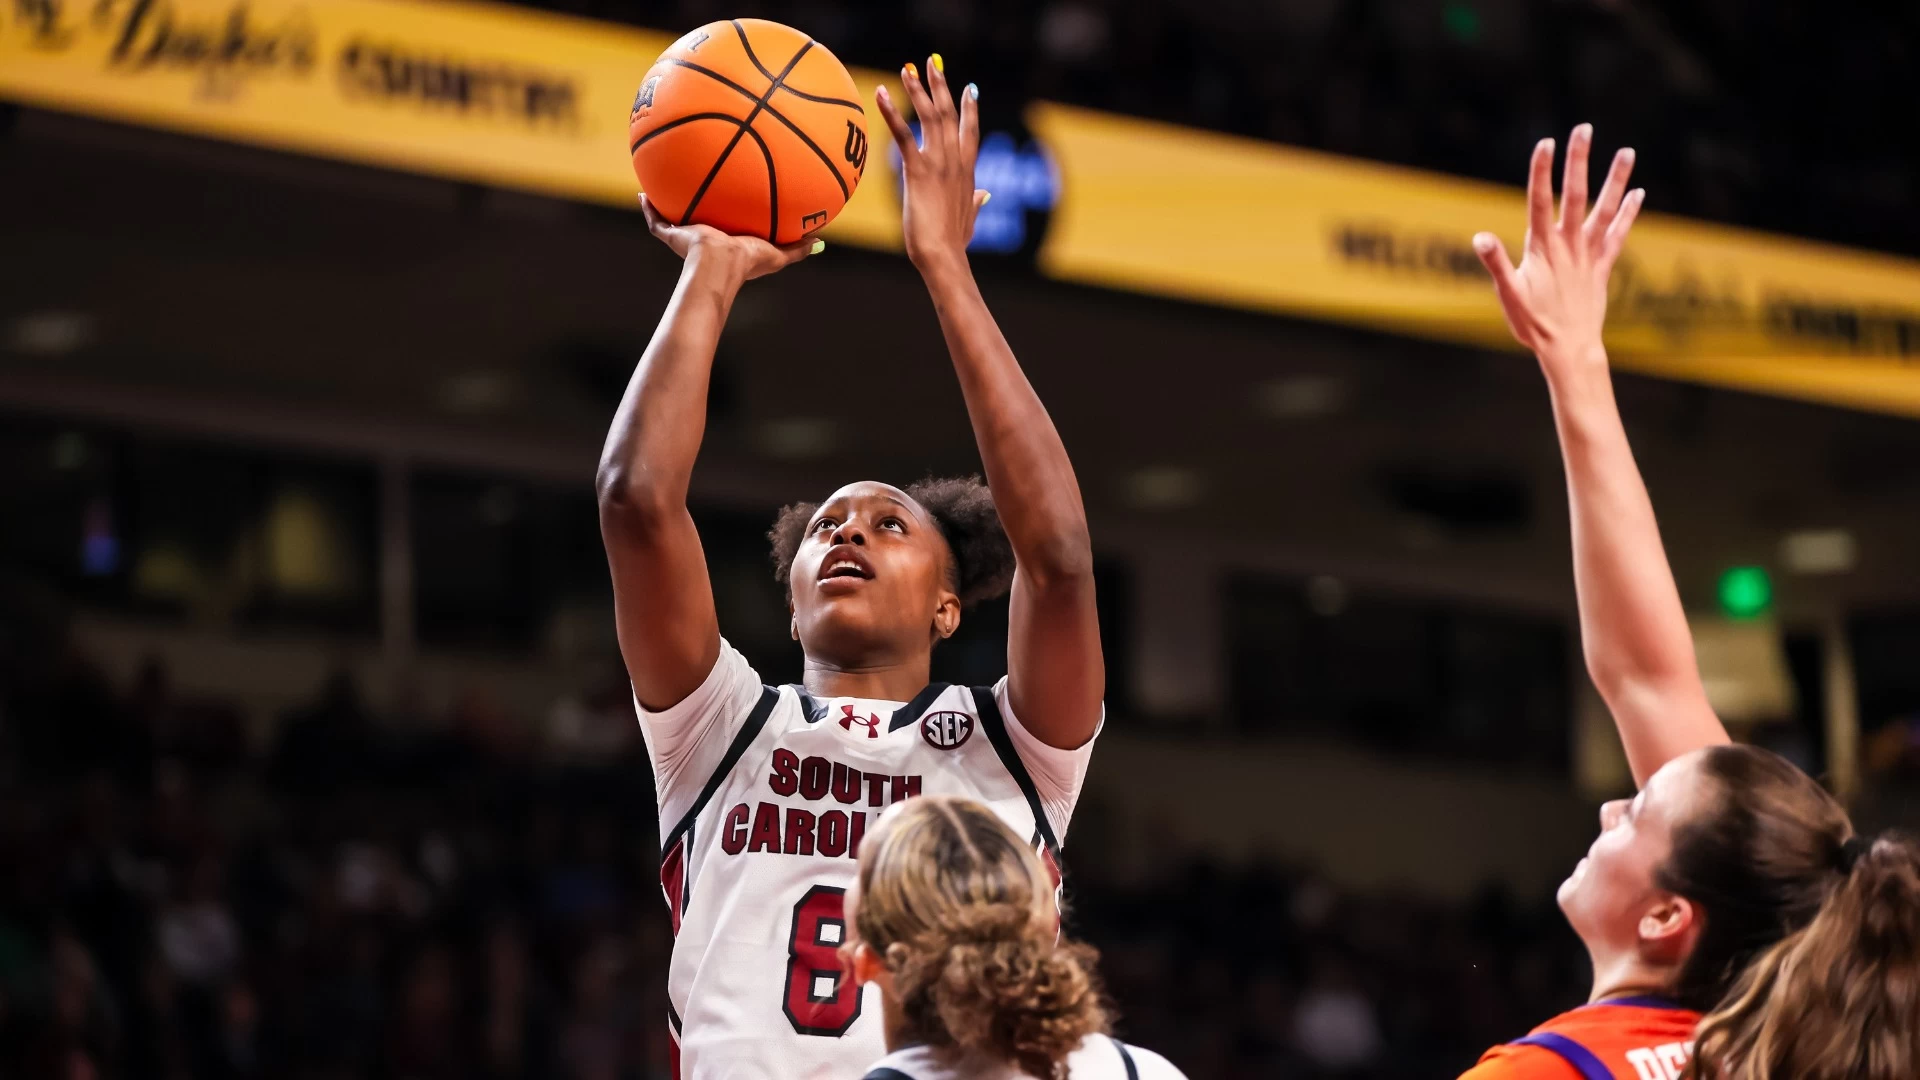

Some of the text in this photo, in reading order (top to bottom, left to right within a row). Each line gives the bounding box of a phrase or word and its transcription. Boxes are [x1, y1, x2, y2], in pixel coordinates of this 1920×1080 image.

[926, 712, 969, 746] SEC
[769, 748, 922, 807] SOUTH
[721, 801, 882, 859] CAROL
[782, 884, 864, 1038] 8
